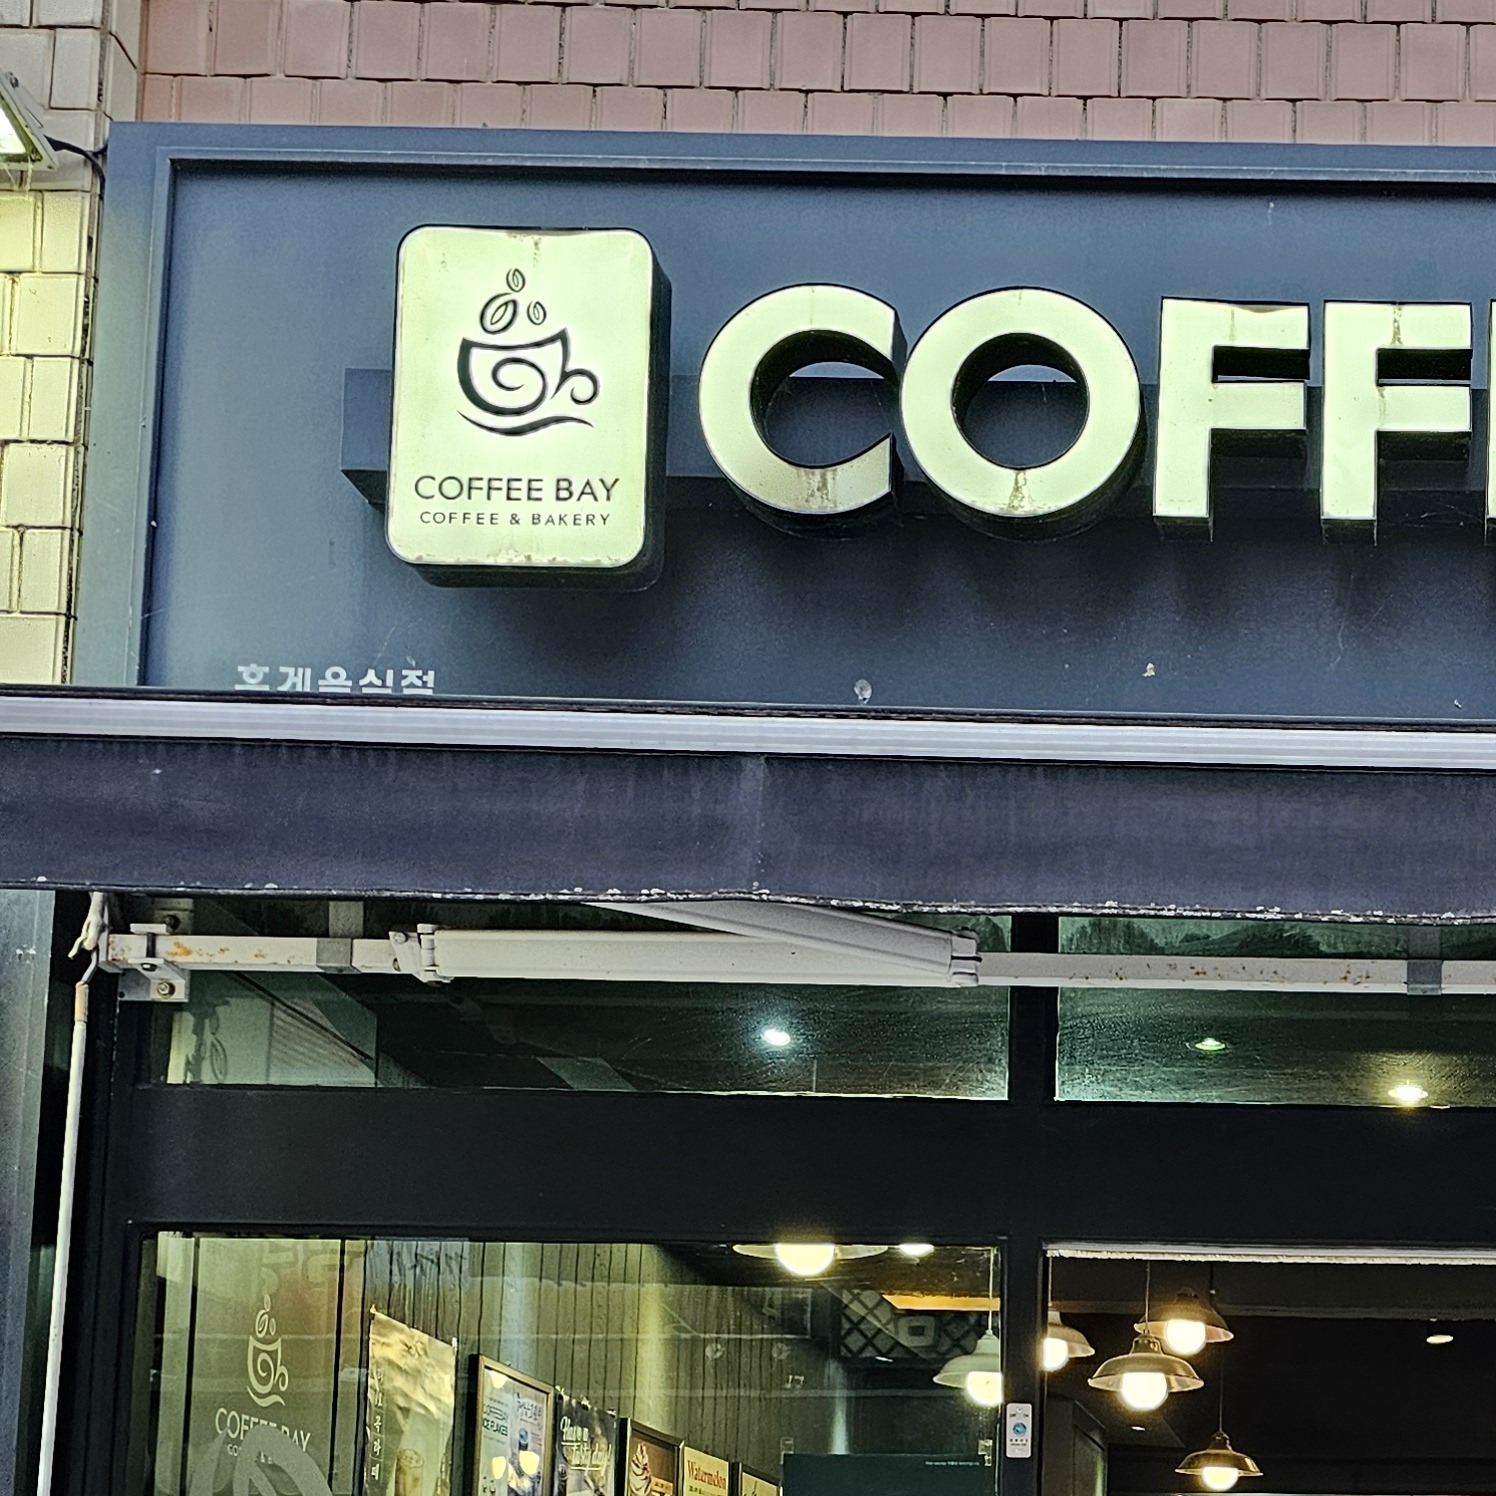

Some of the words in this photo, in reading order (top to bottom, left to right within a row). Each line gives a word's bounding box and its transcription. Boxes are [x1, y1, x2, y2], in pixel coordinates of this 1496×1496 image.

[415, 475, 543, 500] COFFEE
[555, 478, 619, 502] BAY
[420, 511, 499, 525] COFFEE
[509, 513, 520, 526] &
[531, 513, 610, 526] BAKERY
[687, 1459, 726, 1491] Watermelon
